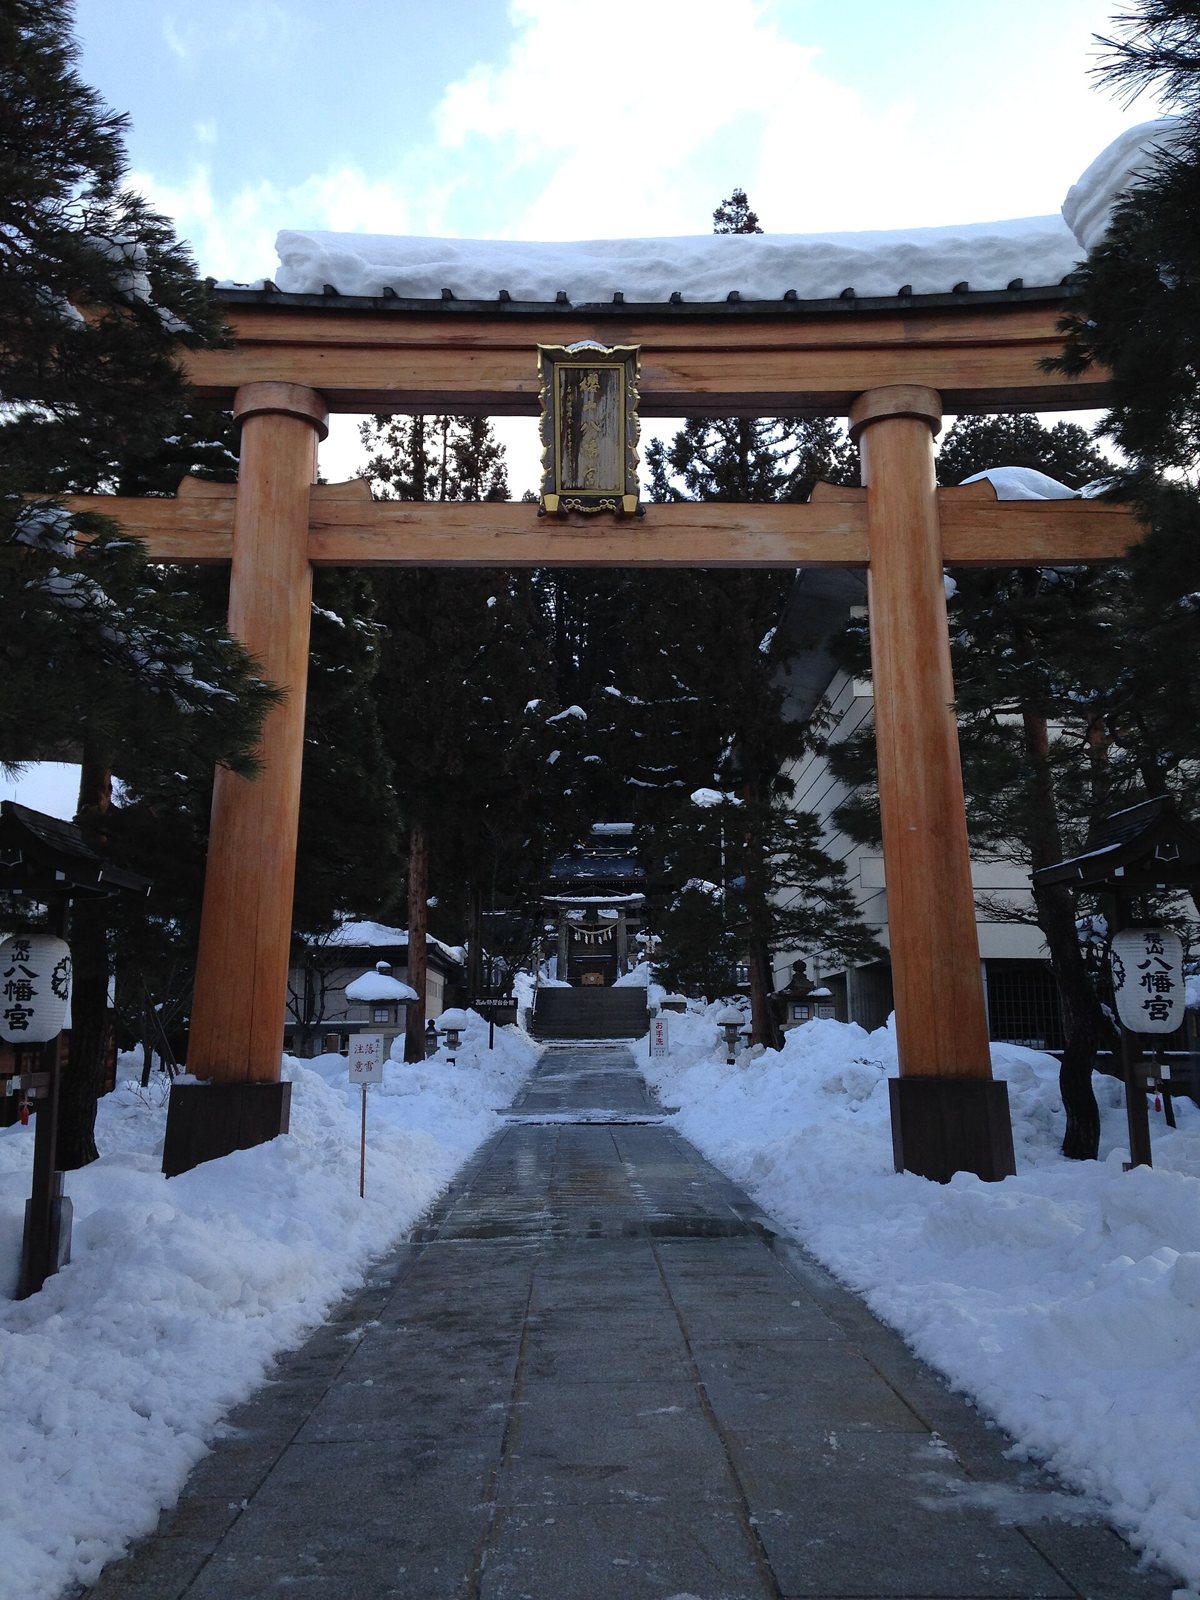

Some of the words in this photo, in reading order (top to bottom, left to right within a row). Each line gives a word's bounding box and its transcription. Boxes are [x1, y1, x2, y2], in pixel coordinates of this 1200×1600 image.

[655, 1022, 664, 1046] お手洗
[354, 1043, 364, 1072] 注意
[364, 1043, 374, 1072] 落雪
